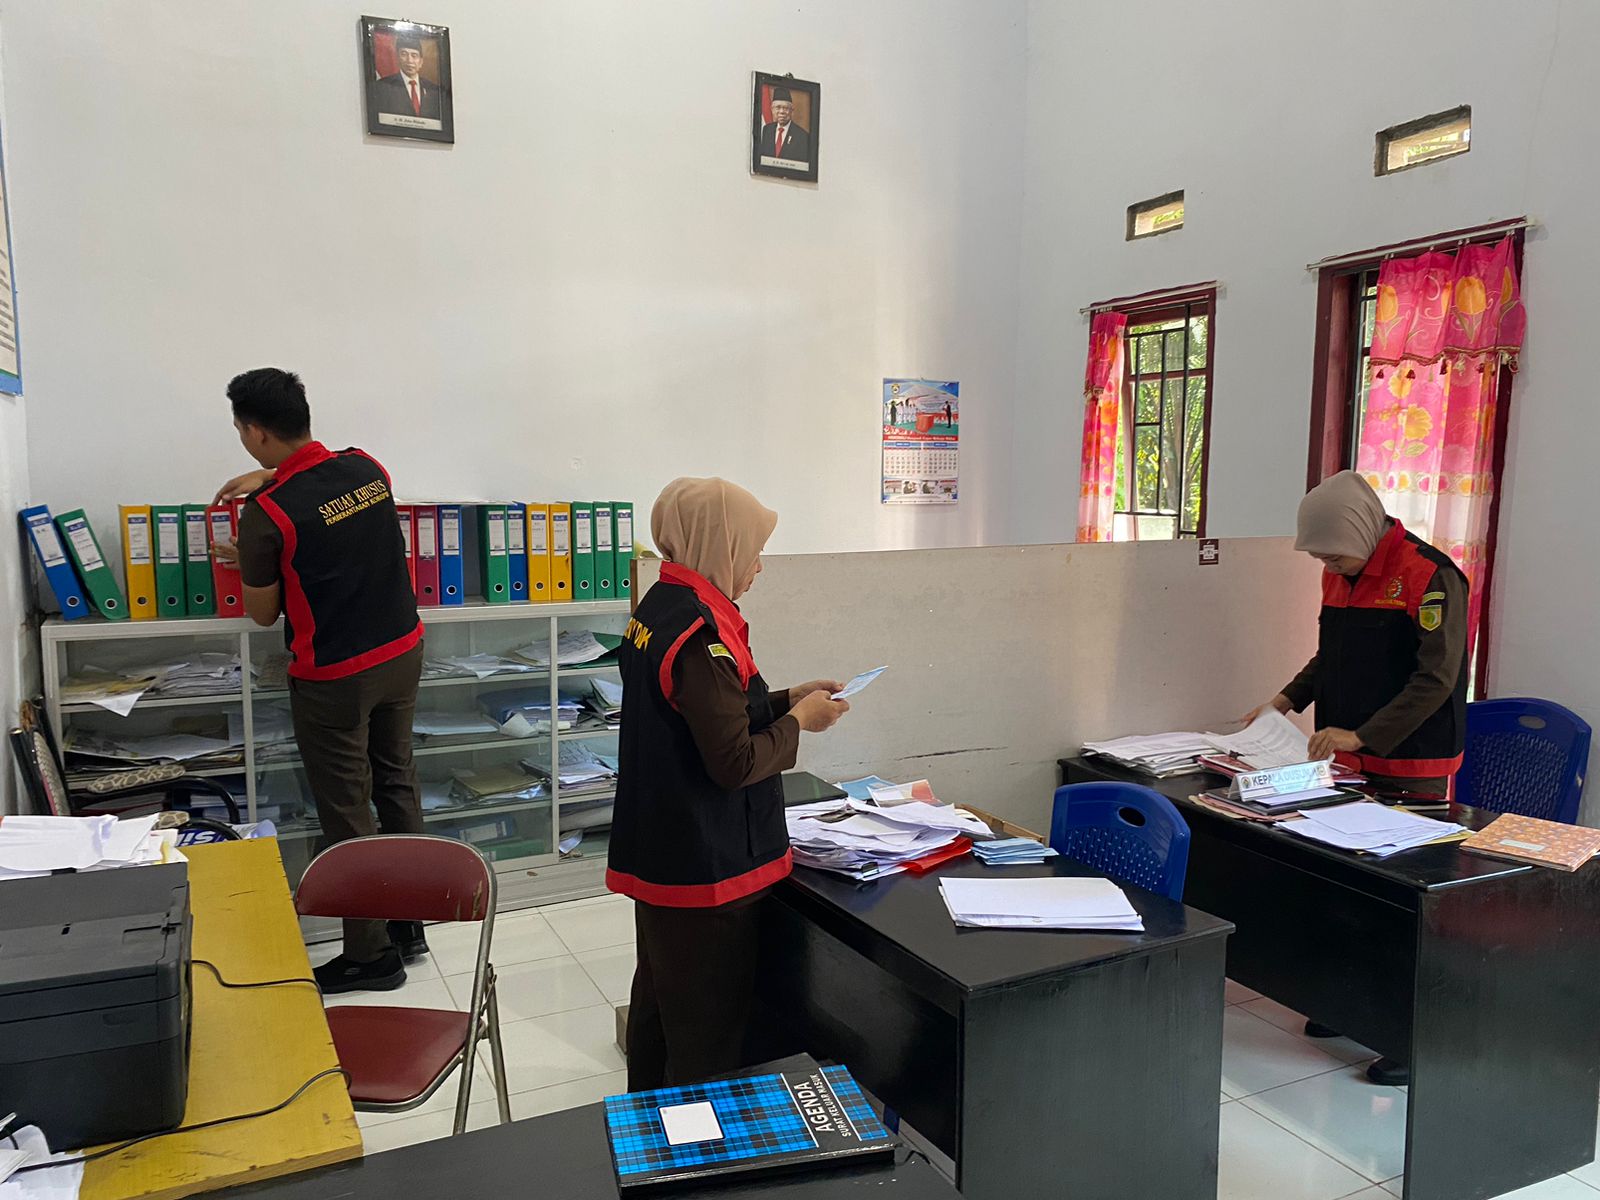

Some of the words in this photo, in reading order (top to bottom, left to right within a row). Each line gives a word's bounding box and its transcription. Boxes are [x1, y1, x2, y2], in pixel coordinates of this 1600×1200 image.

[318, 493, 356, 519] SATUAN
[353, 480, 387, 502] KHUSUS
[1251, 772, 1285, 786] KEPALA
[810, 1073, 827, 1094] MASUK
[794, 1081, 835, 1132] AGENDA
[821, 1093, 840, 1116] KELUAR
[834, 1117, 852, 1137] SURAT
